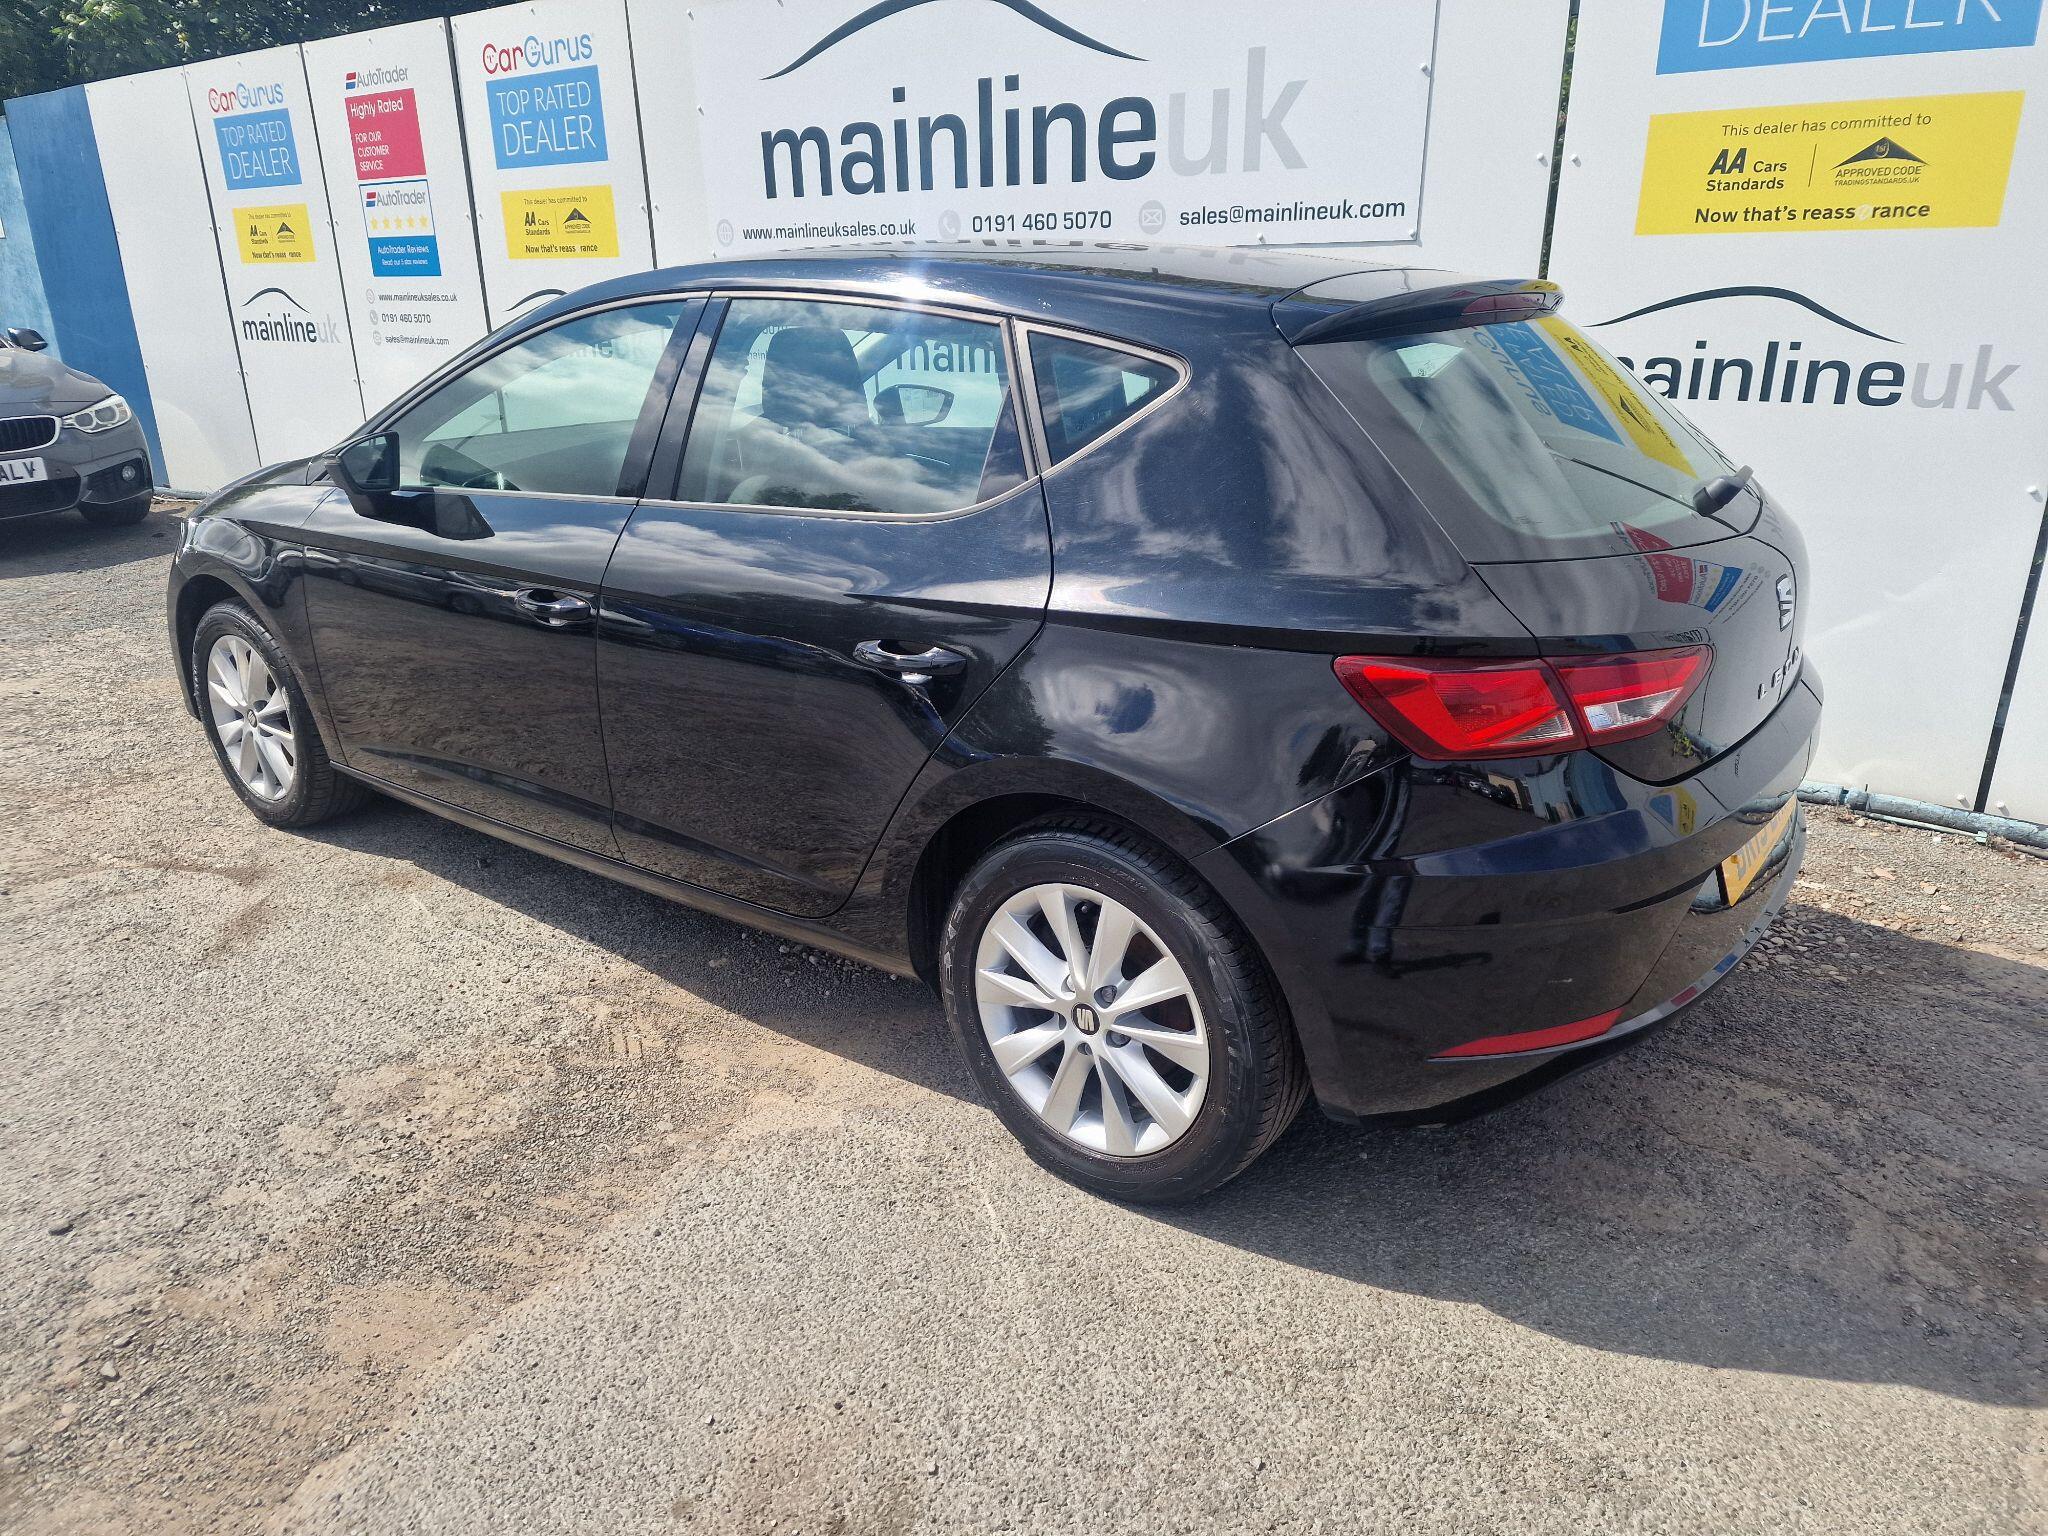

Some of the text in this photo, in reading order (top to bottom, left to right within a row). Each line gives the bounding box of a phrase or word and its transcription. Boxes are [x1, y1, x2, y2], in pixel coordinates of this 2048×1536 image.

[482, 33, 593, 75] CarGurus
[357, 65, 408, 88] AutoTrader
[208, 82, 284, 113] CarGurus
[350, 96, 404, 119] Highly Rated
[495, 81, 591, 116] TOP RATED
[220, 120, 287, 147] TOP RATED
[760, 46, 1310, 200] mainlineuk
[1722, 113, 1932, 136] This dealer has committed to
[355, 131, 382, 143] FOR OUR
[502, 114, 597, 156] DEALER
[357, 144, 390, 157] CUSTOMER
[1708, 147, 1787, 175] AA Cars
[228, 147, 294, 179] DEALER
[359, 160, 384, 171] SERVICE
[1836, 165, 1921, 179] APPROVED CODE
[1706, 177, 1785, 192] Standards
[376, 189, 426, 206] AutoTrader
[525, 212, 537, 226] AA
[972, 210, 1112, 233] 0191 460 5070
[1179, 199, 1406, 225] sales@mainlineuk.com
[1694, 207, 1738, 224] Now
[525, 228, 551, 236] Standards
[742, 219, 916, 240] www.mainlineuksales.co.uk
[407, 244, 430, 253] Reviews
[525, 245, 539, 253] Now
[242, 312, 343, 343] mainlineuk
[381, 313, 398, 323] 0191
[413, 313, 432, 324] 5070
[1616, 341, 2021, 412] ainlineuk
